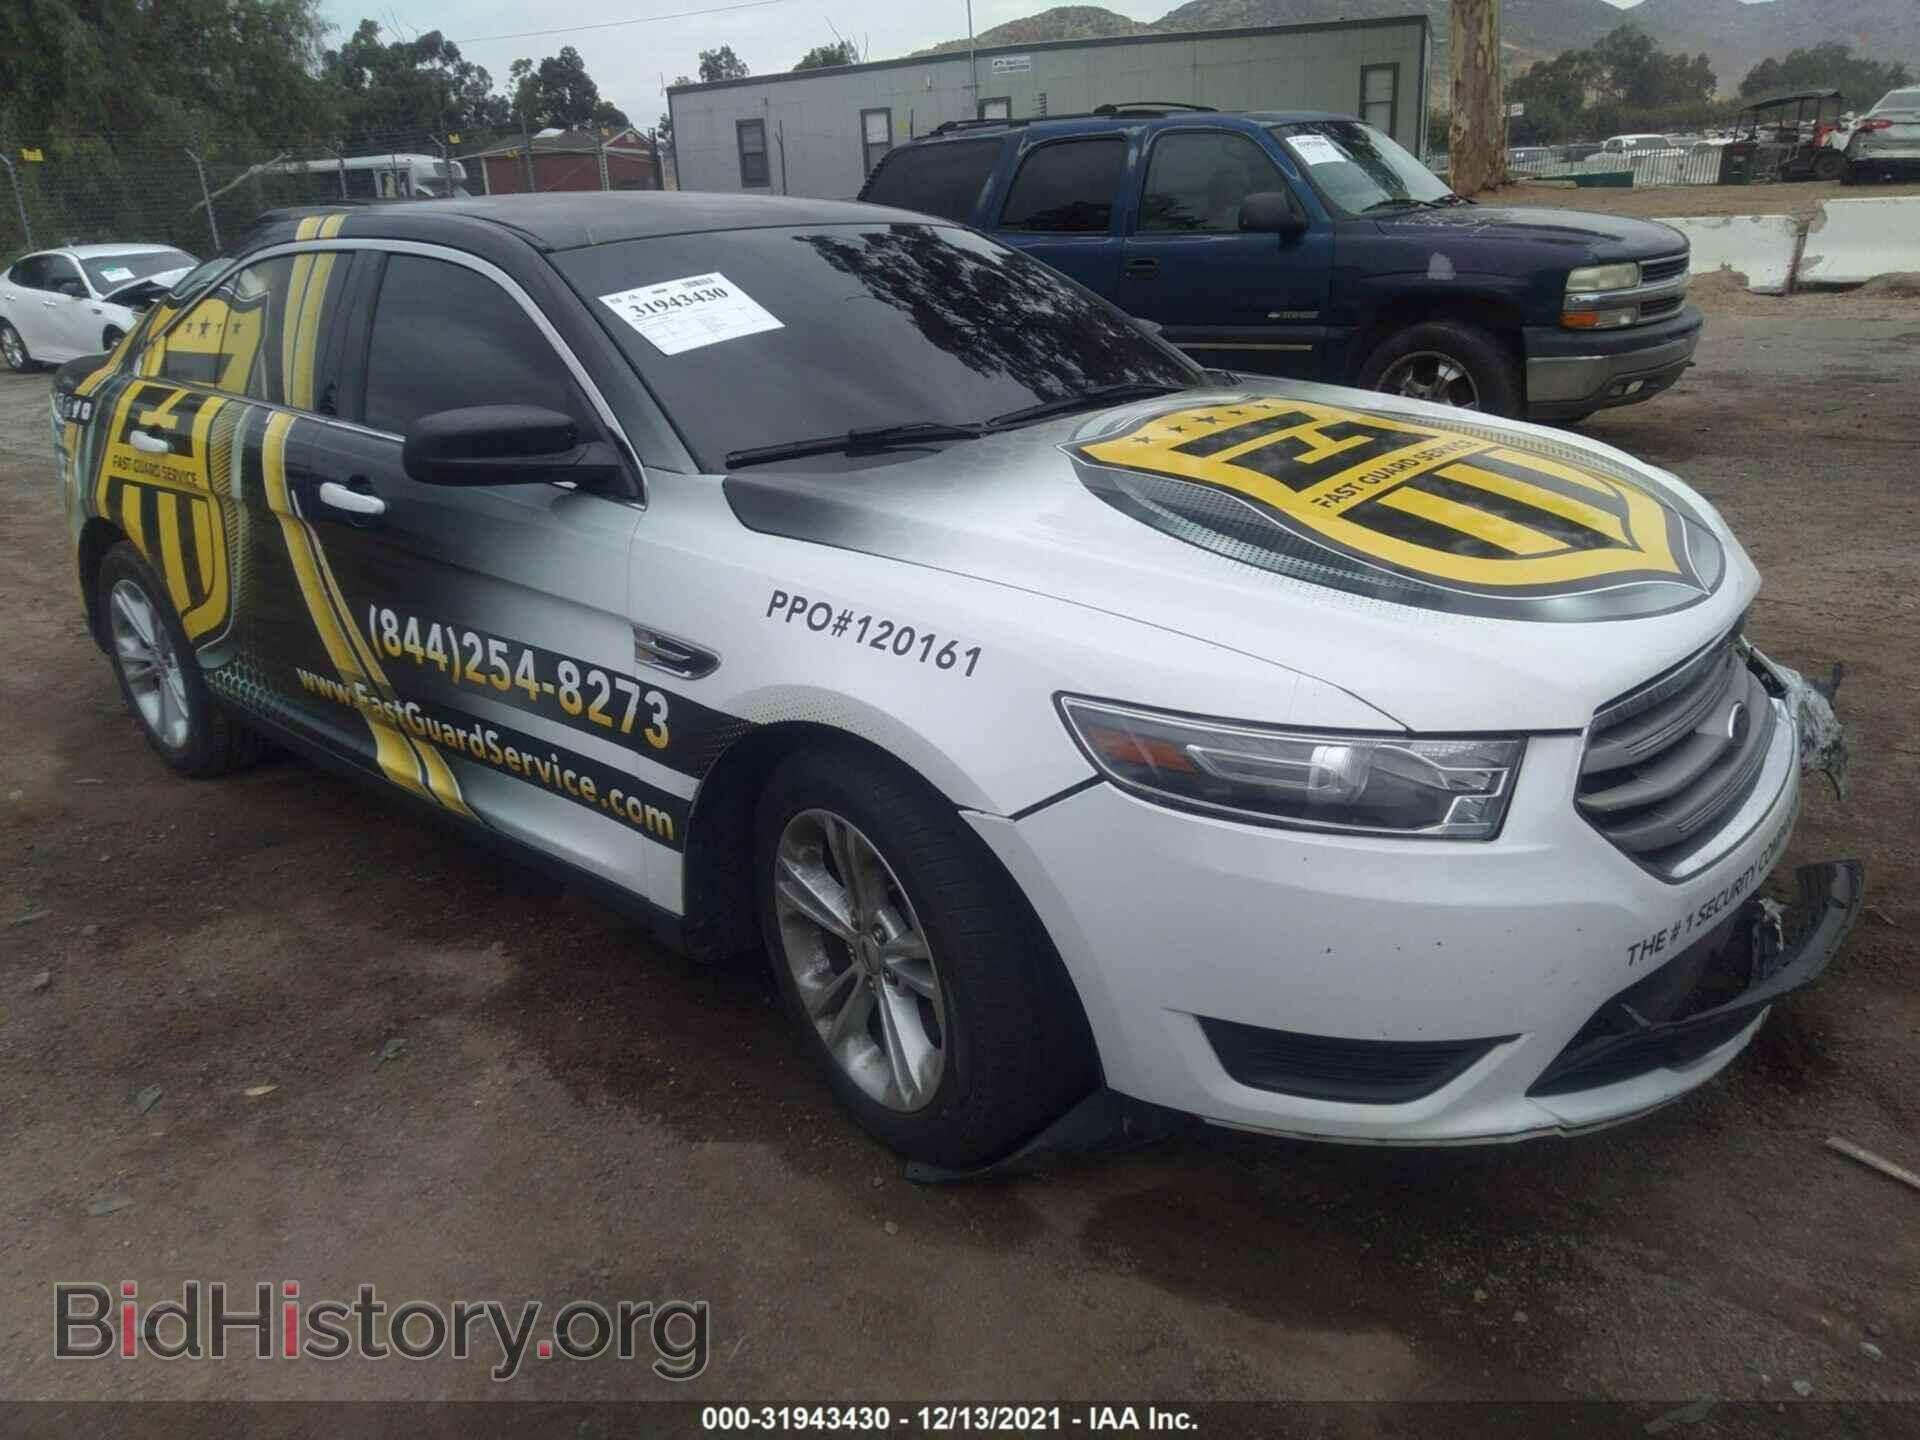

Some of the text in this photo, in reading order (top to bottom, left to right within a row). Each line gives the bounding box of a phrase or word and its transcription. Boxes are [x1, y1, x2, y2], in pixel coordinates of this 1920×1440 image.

[629, 287, 729, 318] 31943430
[113, 454, 132, 471] FAST
[162, 465, 198, 488] SERVICE
[1311, 482, 1364, 508] FAST
[1358, 458, 1421, 485] GUARD
[369, 603, 670, 750] (844)254-8273
[766, 589, 982, 678] PPO#120161
[296, 668, 674, 841] www.FastGuardService.com
[1627, 927, 1667, 967] THE
[1696, 857, 1758, 927] SECURITY
